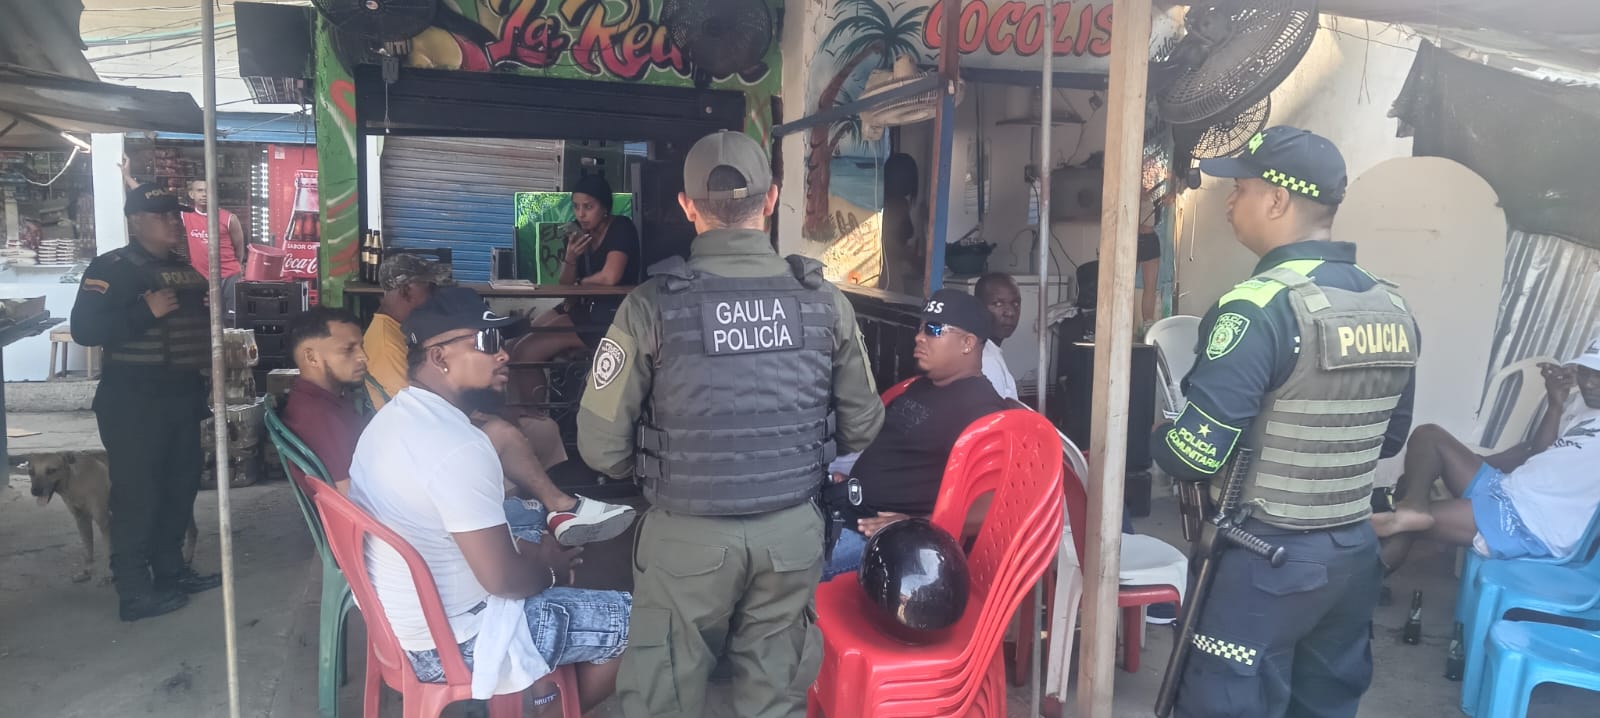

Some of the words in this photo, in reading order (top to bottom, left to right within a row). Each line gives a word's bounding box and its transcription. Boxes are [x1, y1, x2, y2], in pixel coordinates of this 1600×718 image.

[716, 298, 785, 325] GAULA
[713, 320, 793, 352] POLICÍA
[1338, 323, 1410, 357] POLICIA
[1179, 427, 1217, 457] POLICÍA
